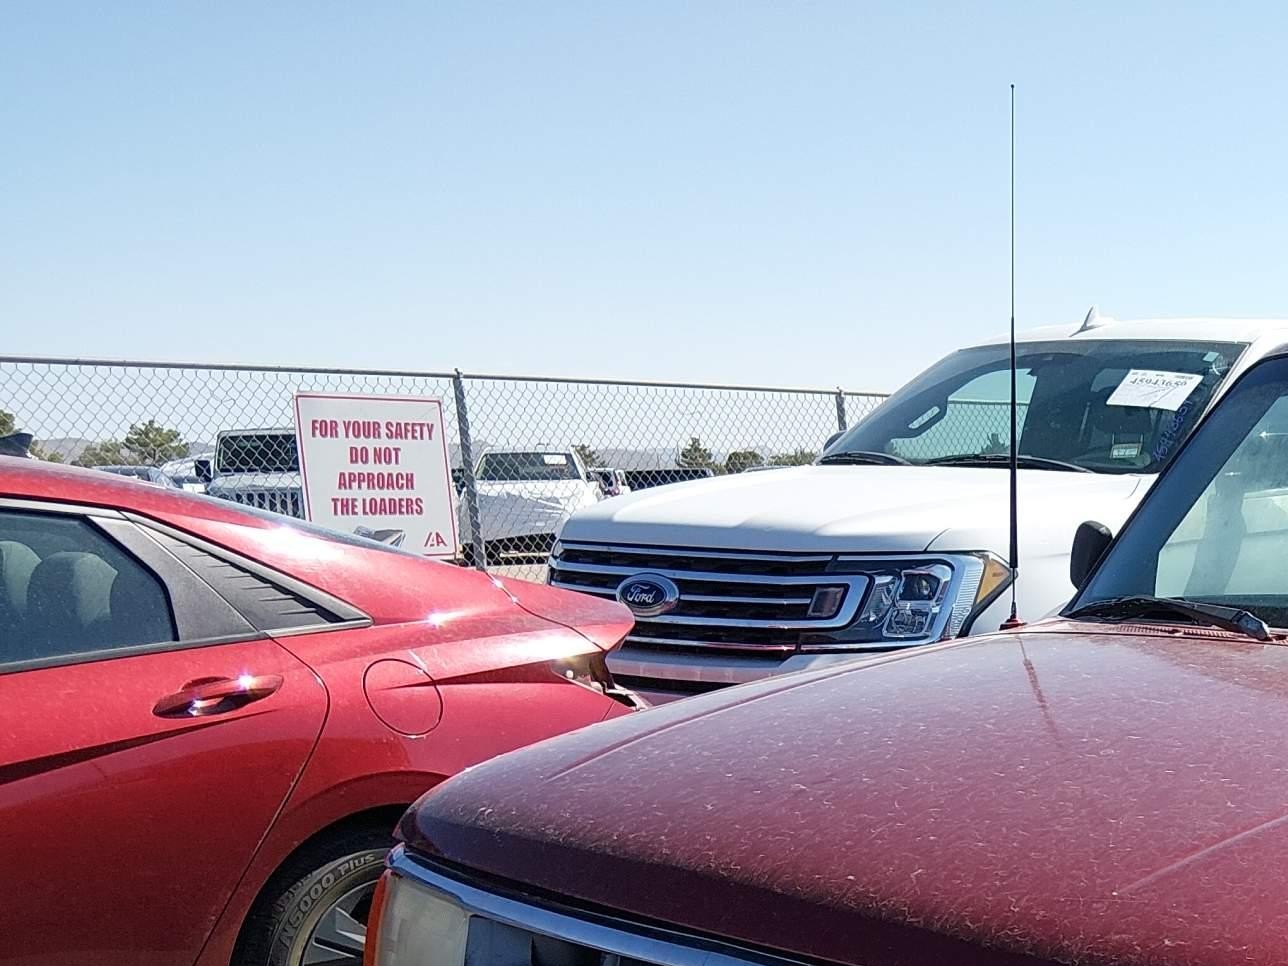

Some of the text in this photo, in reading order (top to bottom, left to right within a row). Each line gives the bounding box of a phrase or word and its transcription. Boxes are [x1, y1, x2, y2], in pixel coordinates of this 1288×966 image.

[311, 419, 435, 441] FOR YOUR SAFETY
[349, 446, 401, 465] DO NOT
[338, 472, 415, 490] APPROACH
[331, 497, 424, 516] THE LOADERS
[626, 583, 657, 604] Ford
